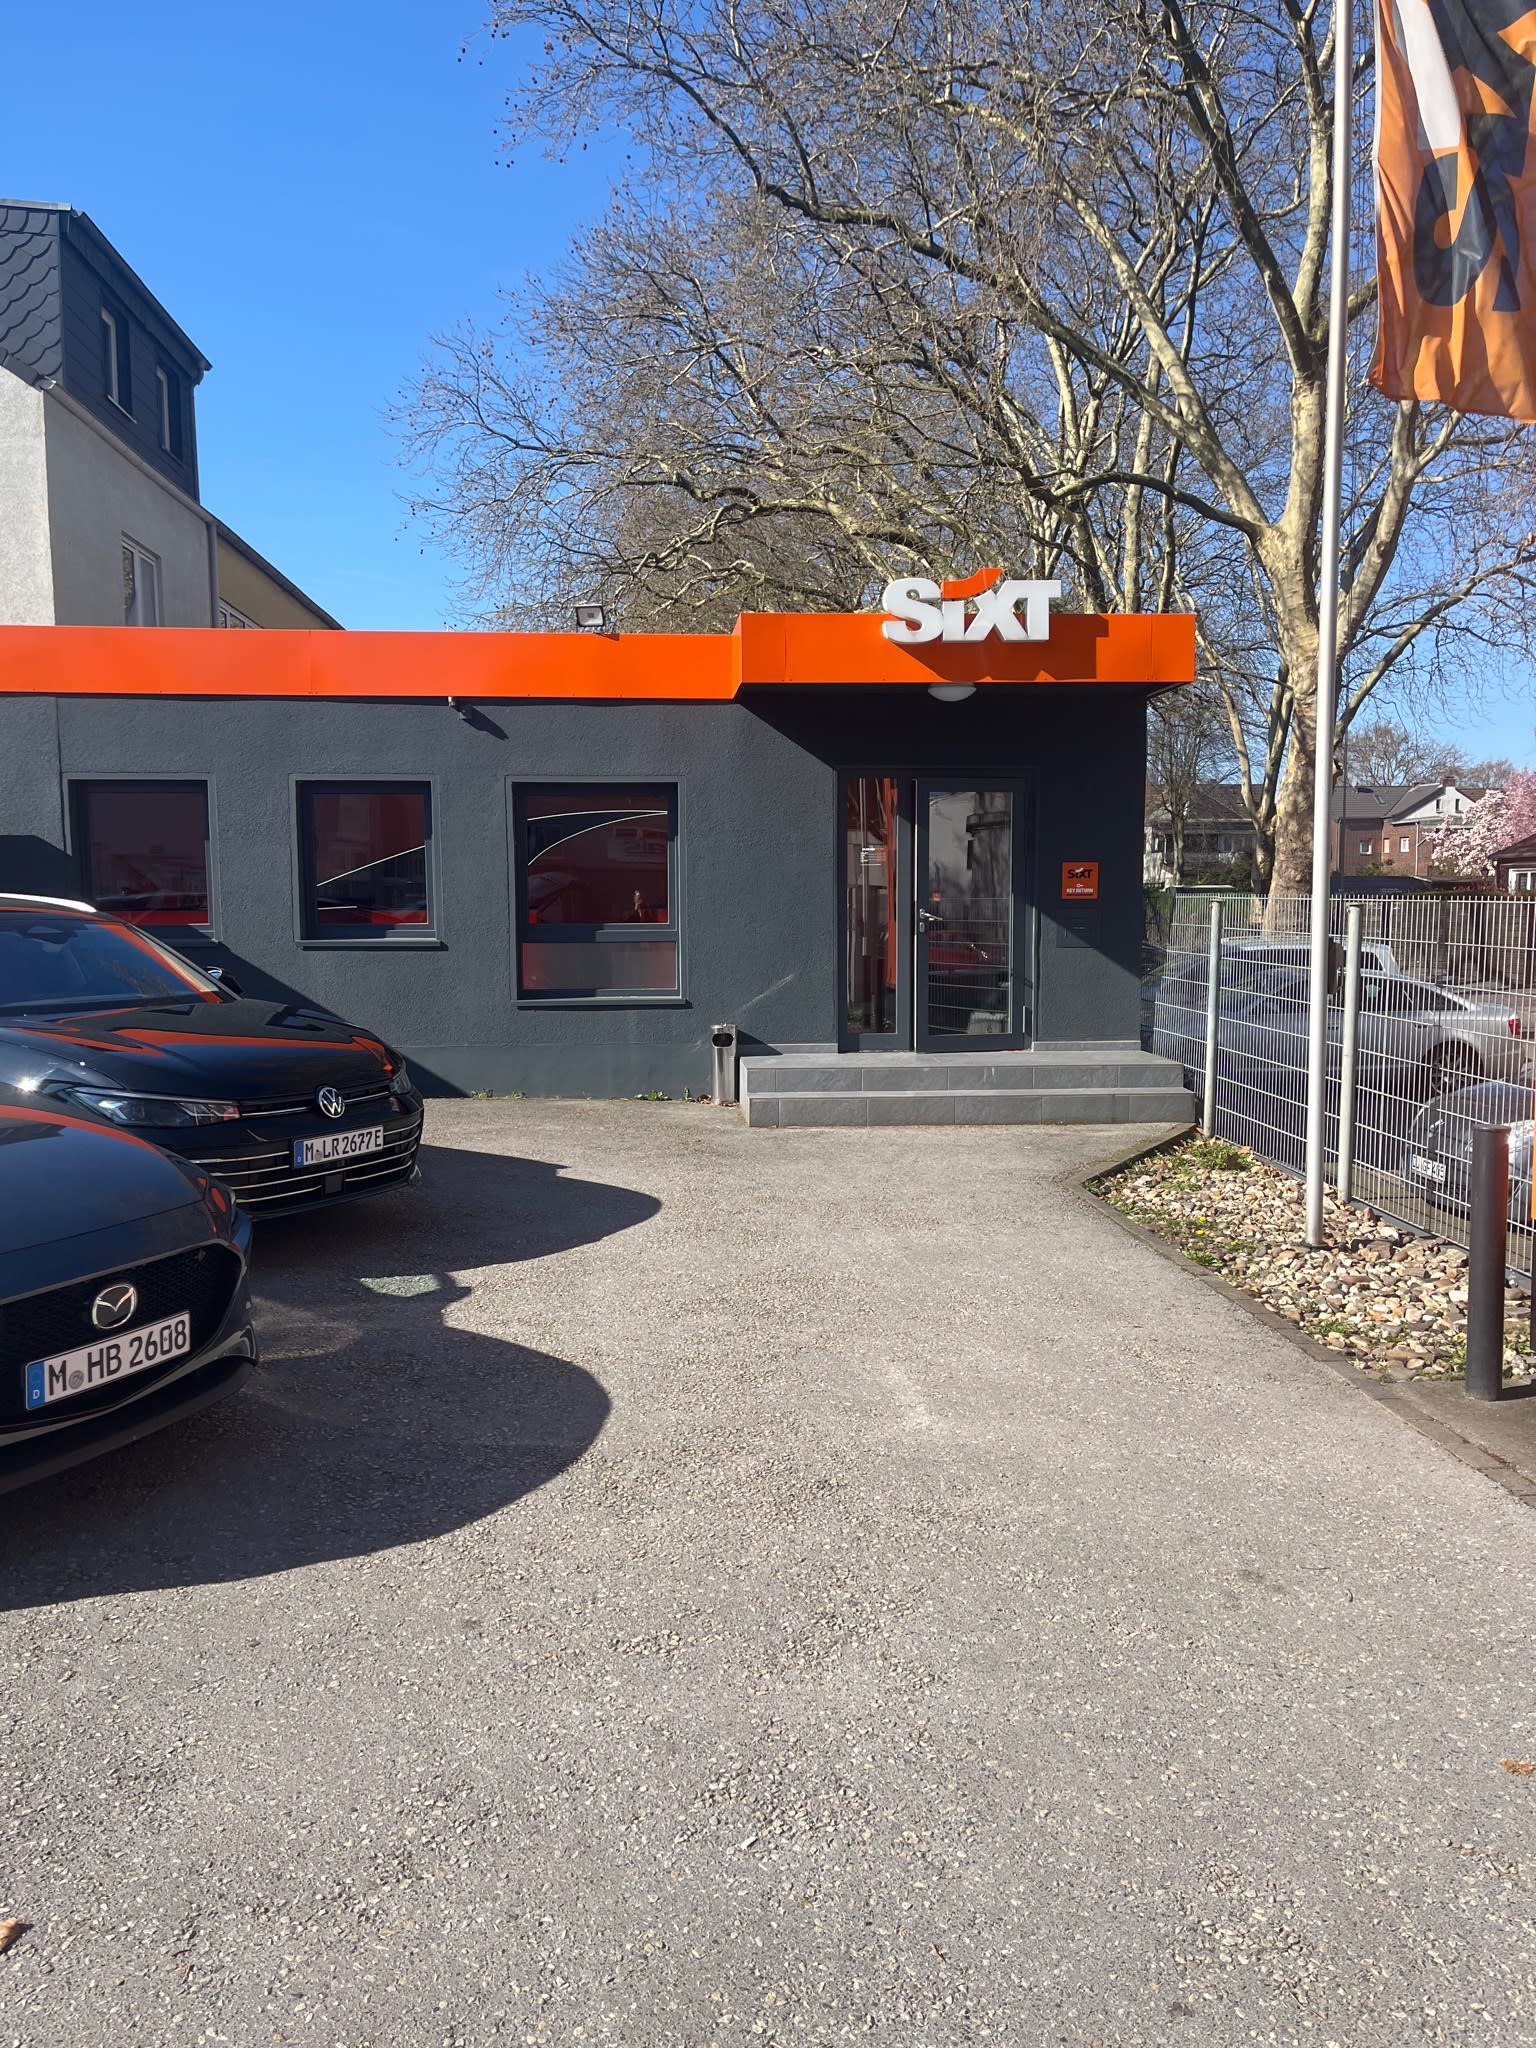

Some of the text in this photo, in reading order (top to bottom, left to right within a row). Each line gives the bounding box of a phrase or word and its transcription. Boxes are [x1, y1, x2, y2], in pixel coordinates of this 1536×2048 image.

[305, 1142, 314, 1162] M
[323, 1138, 340, 1159] LR
[32, 1319, 187, 1400] D M HB 2608
